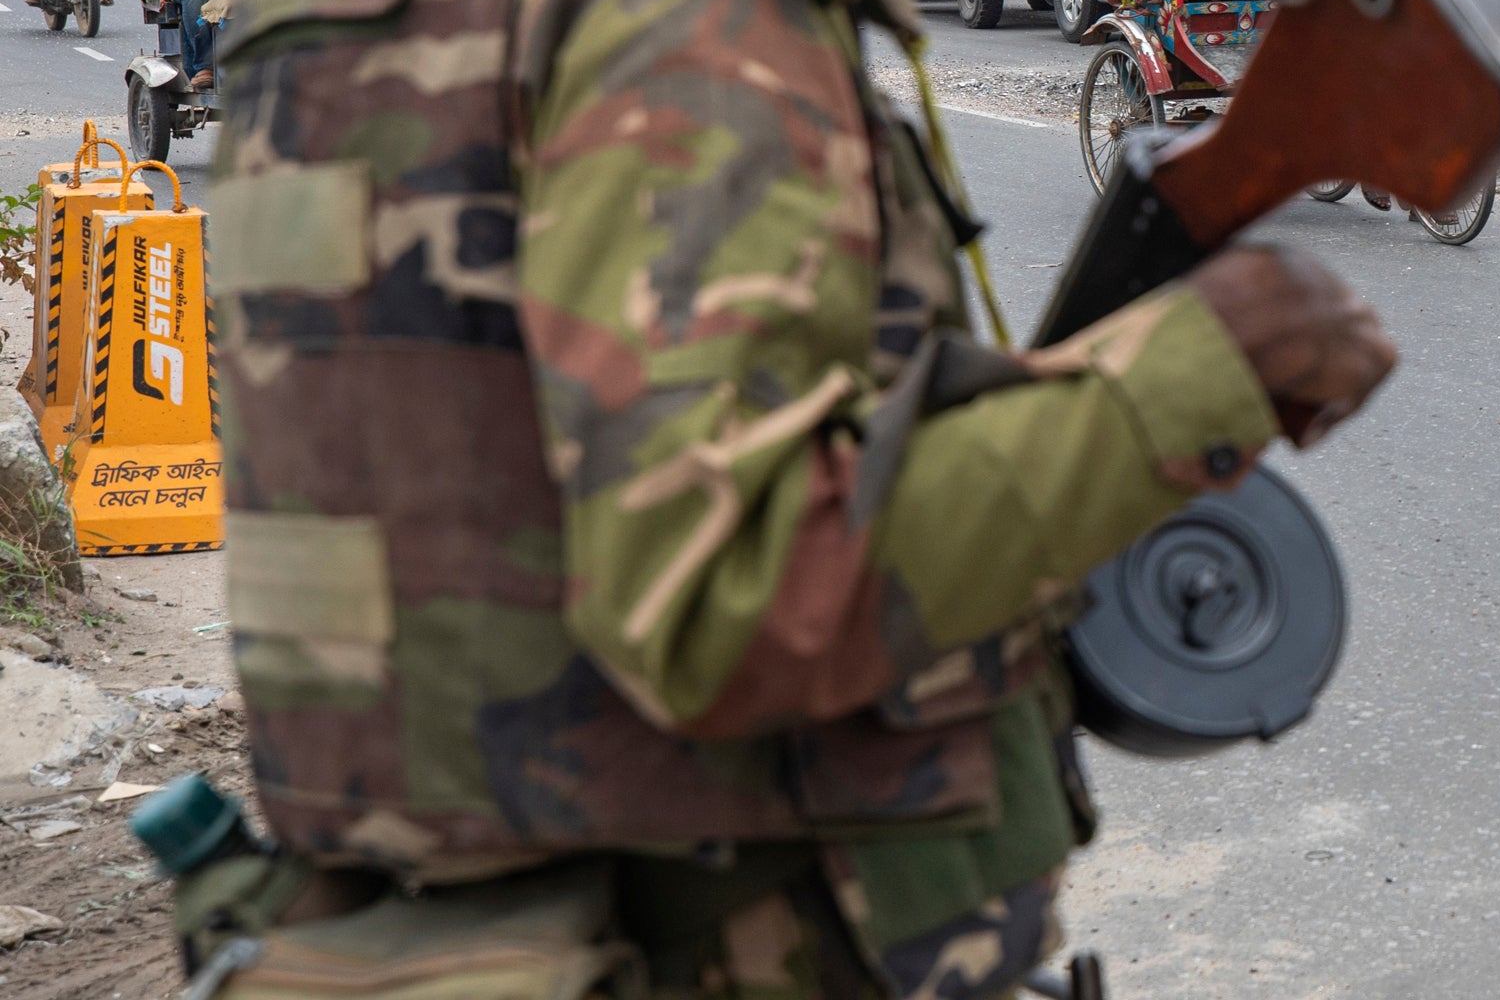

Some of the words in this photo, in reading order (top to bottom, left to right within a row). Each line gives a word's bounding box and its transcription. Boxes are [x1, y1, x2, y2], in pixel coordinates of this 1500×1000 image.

[133, 236, 147, 332] JULFIKAR
[149, 242, 172, 338] STEEL
[91, 460, 161, 487] ট্রাফিক
[167, 458, 223, 480] আইন
[99, 489, 150, 508] মেনে
[155, 486, 207, 508] চলুন
